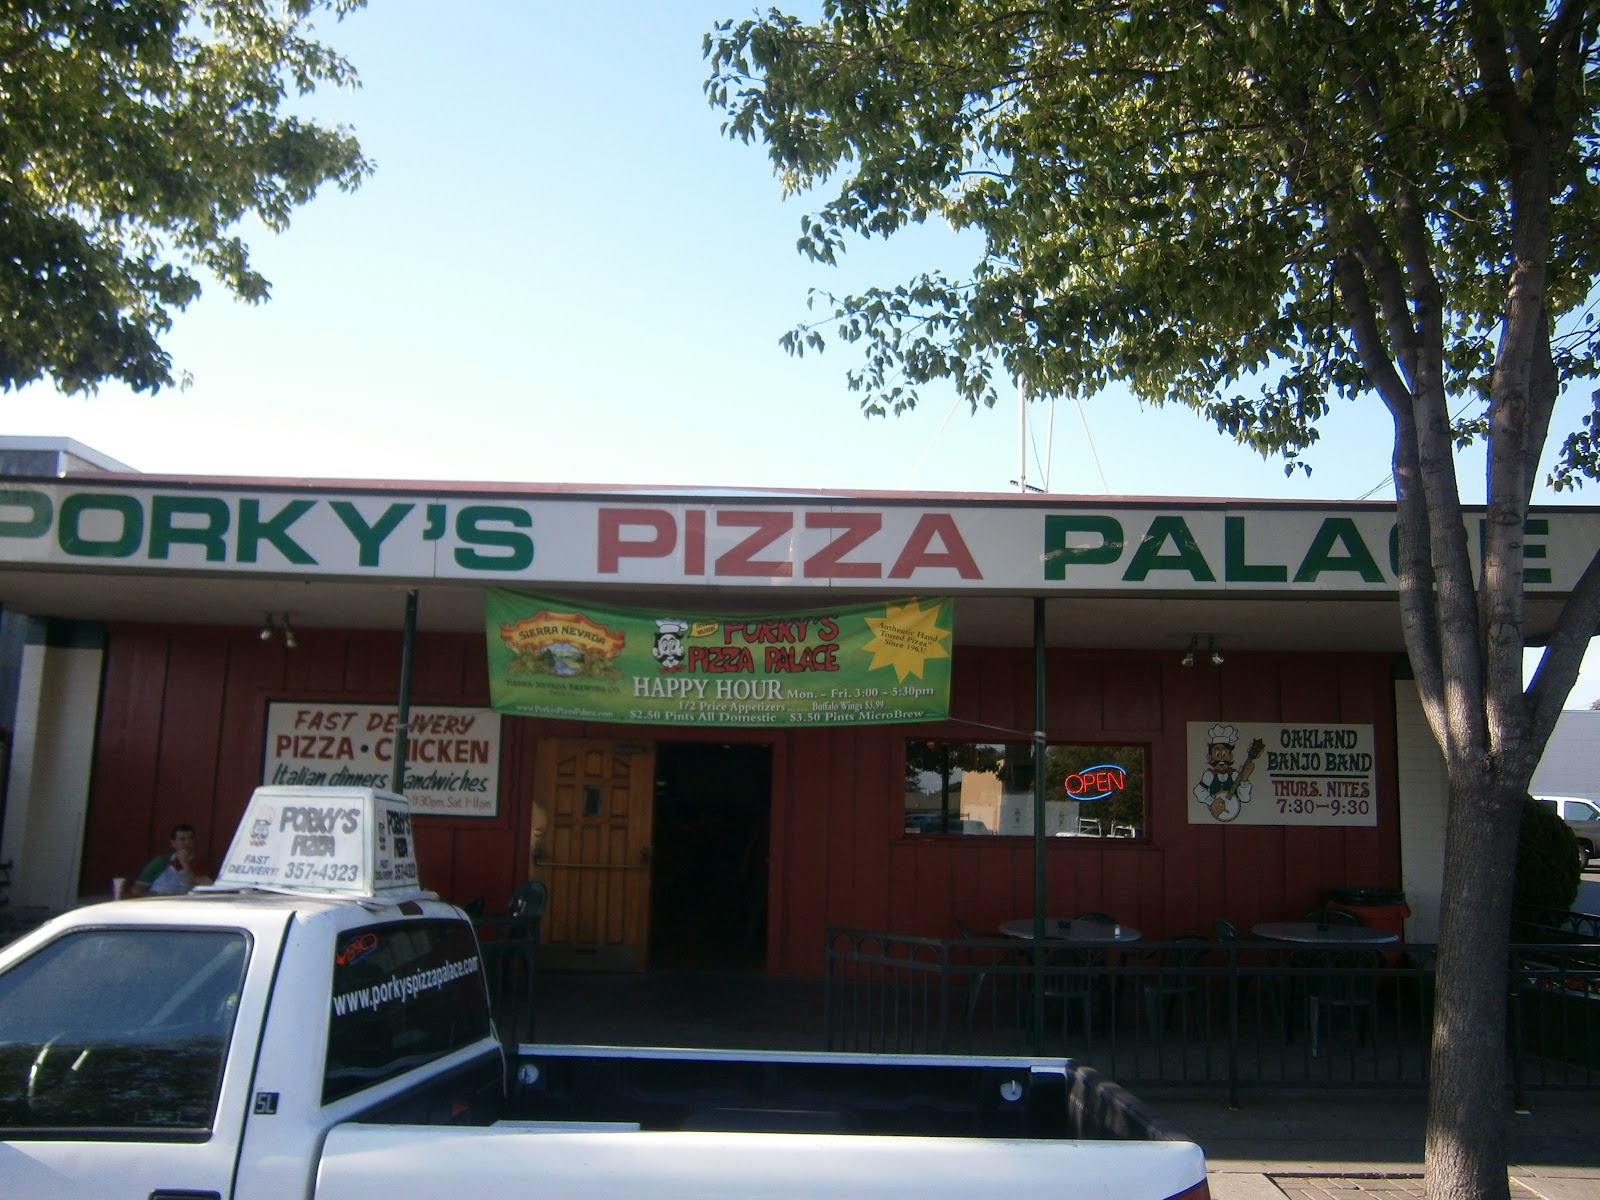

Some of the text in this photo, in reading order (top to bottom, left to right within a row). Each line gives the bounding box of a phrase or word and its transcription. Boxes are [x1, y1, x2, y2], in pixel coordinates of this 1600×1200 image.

[0, 489, 1552, 583] PORKY'S PIZZA PALAE
[518, 625, 606, 645] SIERRA NEVADA
[723, 614, 839, 644] PORKY'S
[878, 622, 938, 642] Authentic Hand
[880, 630, 905, 641] Tossed
[884, 639, 926, 654] Since 1963!
[688, 644, 840, 673] PIZZA PALACE
[633, 677, 709, 699] HAPPY
[715, 679, 783, 700] HOUR
[787, 689, 817, 699] Mon.
[831, 688, 851, 698] Fri.
[855, 687, 879, 697] 3:00
[891, 686, 935, 699] 5:30pm
[629, 710, 777, 722] $2.50 Pints All Domestic
[678, 701, 695, 711] 1/2
[699, 702, 727, 711] Price
[729, 702, 786, 714] Appetizers
[789, 709, 924, 722] $3.50 Pints MicroBrew
[812, 702, 839, 711] Buffalo
[840, 701, 863, 712] Wings
[864, 700, 884, 710] $3.99
[294, 710, 476, 735] FAST DEIVERY
[275, 734, 355, 760] PIZZA
[1280, 728, 1358, 749] OAKLAND
[1266, 751, 1373, 772] BANJO BAND
[272, 762, 489, 792] Italian dinners andwiches
[1064, 770, 1125, 794] OPEN
[1271, 780, 1371, 798] THURS. NITES
[279, 806, 361, 834] PORKY'S
[243, 854, 271, 865] FAST
[284, 861, 360, 882] 357-4323
[333, 955, 479, 1017] www.porkyspizzapalace.com
[256, 1094, 275, 1113] SL
